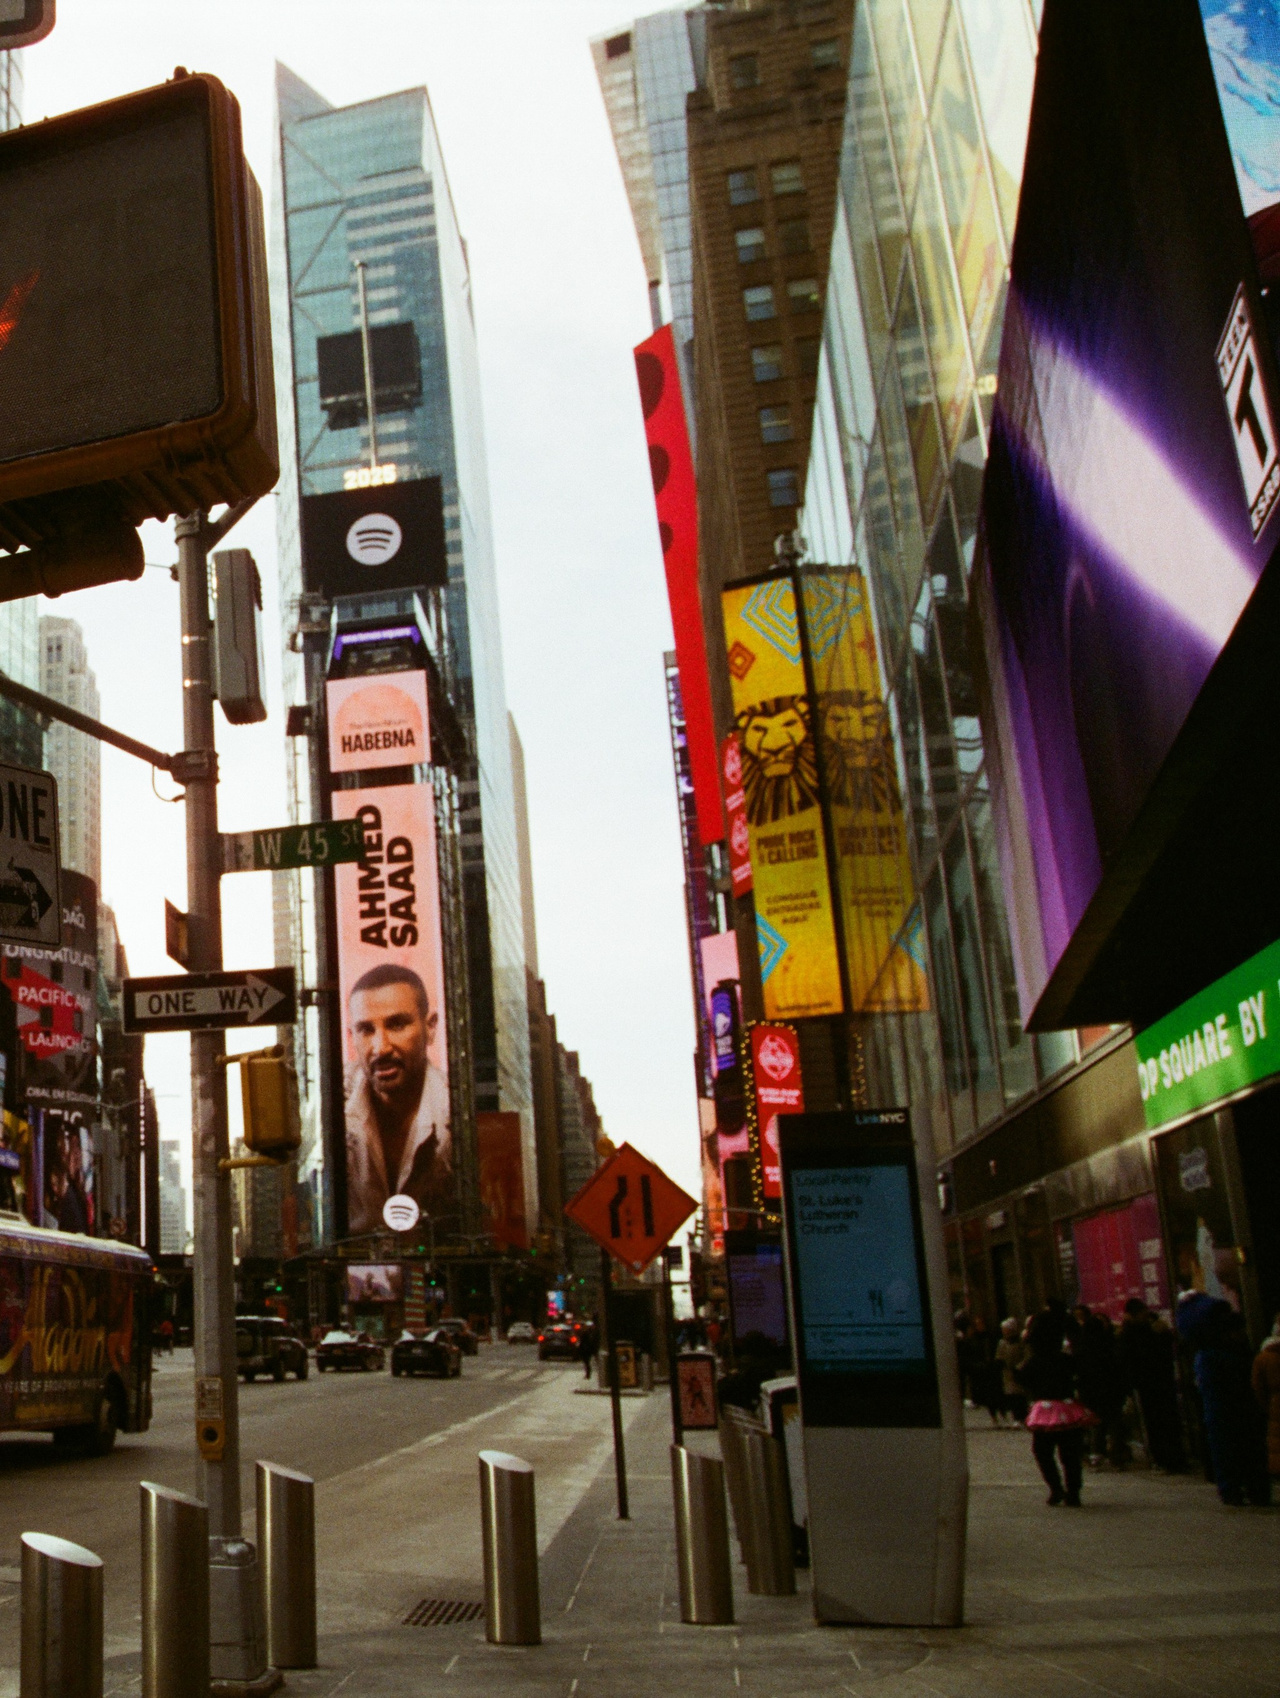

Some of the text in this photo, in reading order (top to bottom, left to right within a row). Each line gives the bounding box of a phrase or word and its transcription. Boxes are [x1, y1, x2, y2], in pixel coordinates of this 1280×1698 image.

[1234, 353, 1269, 472] T
[343, 463, 397, 490] 2025
[341, 728, 415, 754] HABEBNA
[260, 824, 361, 865] W 45 St
[356, 805, 388, 949] AHMED
[387, 836, 418, 947] SAAD
[18, 986, 74, 1008] PACIFIC
[147, 986, 268, 1014] ONE WAY
[1159, 1013, 1233, 1089] SQUARE
[1238, 990, 1267, 1047] BY
